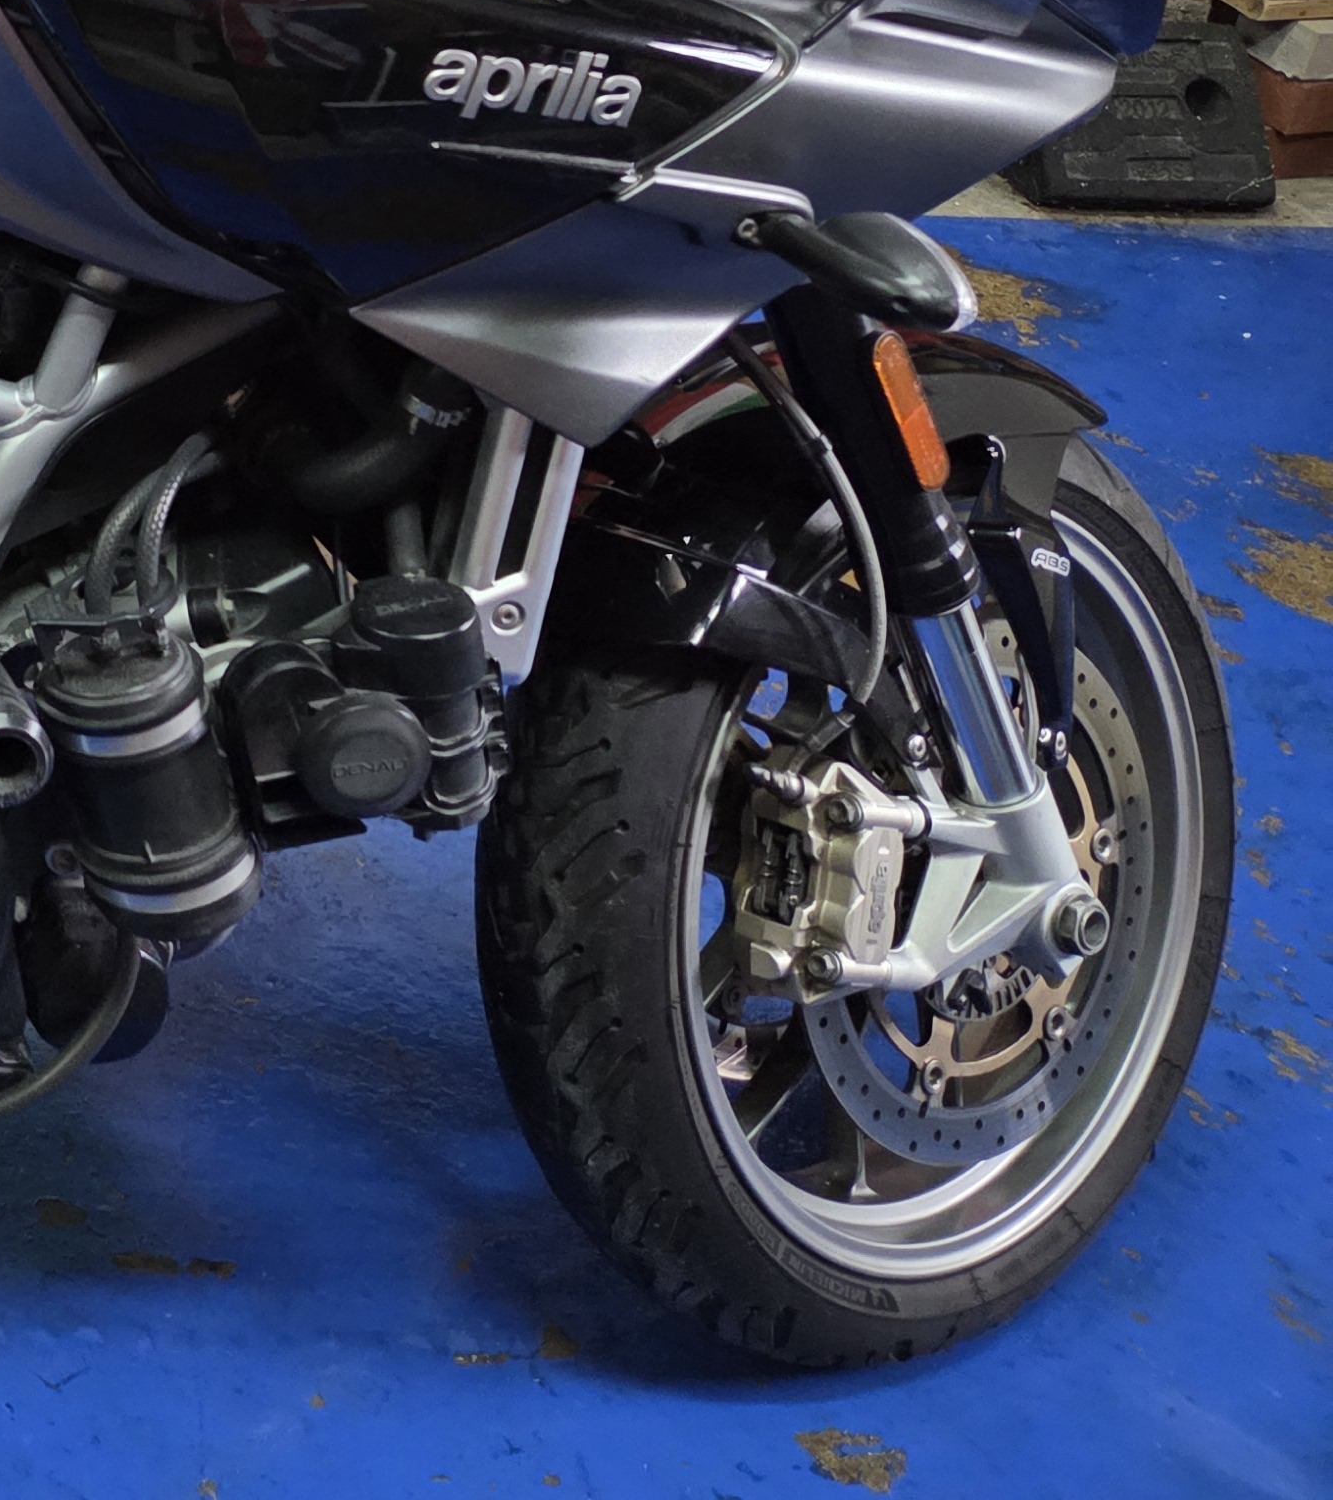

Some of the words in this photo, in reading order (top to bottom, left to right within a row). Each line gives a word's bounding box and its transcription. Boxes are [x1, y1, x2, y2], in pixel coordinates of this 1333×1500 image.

[423, 48, 643, 129] aprilia
[1033, 550, 1070, 575] ABS
[867, 860, 890, 934] aprilia
